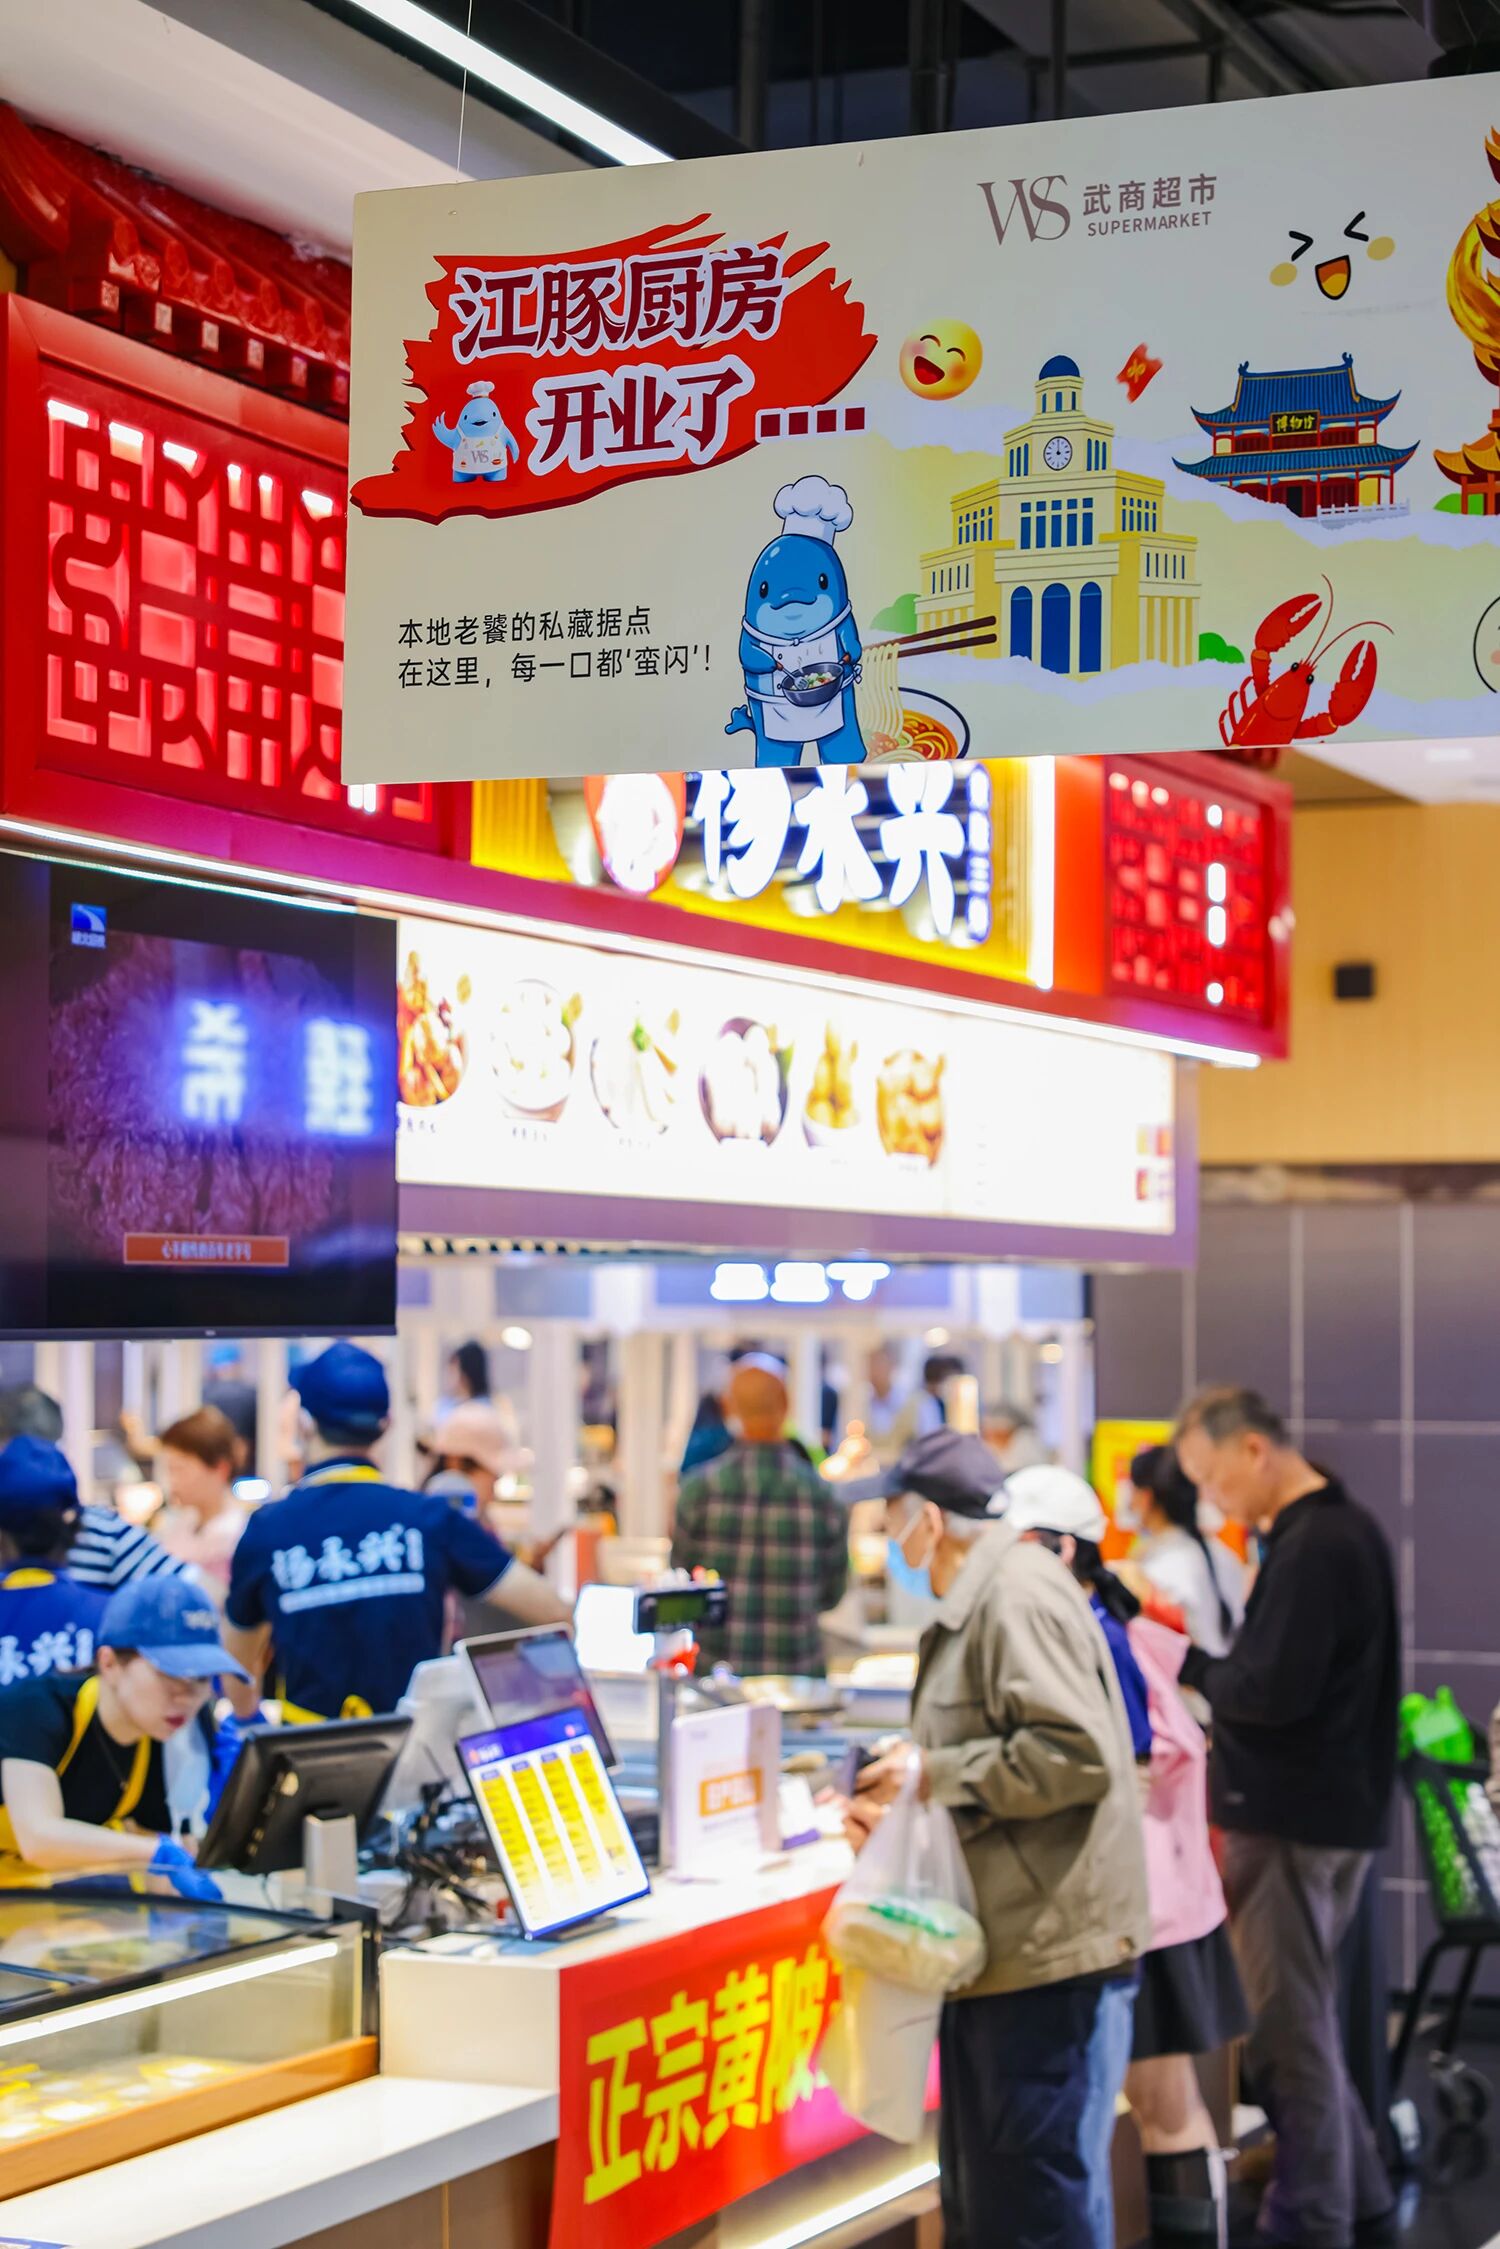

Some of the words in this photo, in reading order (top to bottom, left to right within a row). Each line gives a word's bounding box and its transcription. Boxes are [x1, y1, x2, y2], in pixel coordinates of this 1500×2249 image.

[1083, 173, 1217, 216] 武商超市
[1087, 211, 1212, 237] SUPERMARKET
[452, 244, 786, 361] 江豚厨房
[398, 605, 651, 649] 本地老饕的私藏据点
[583, 1943, 843, 2205] 正宗黄陂
